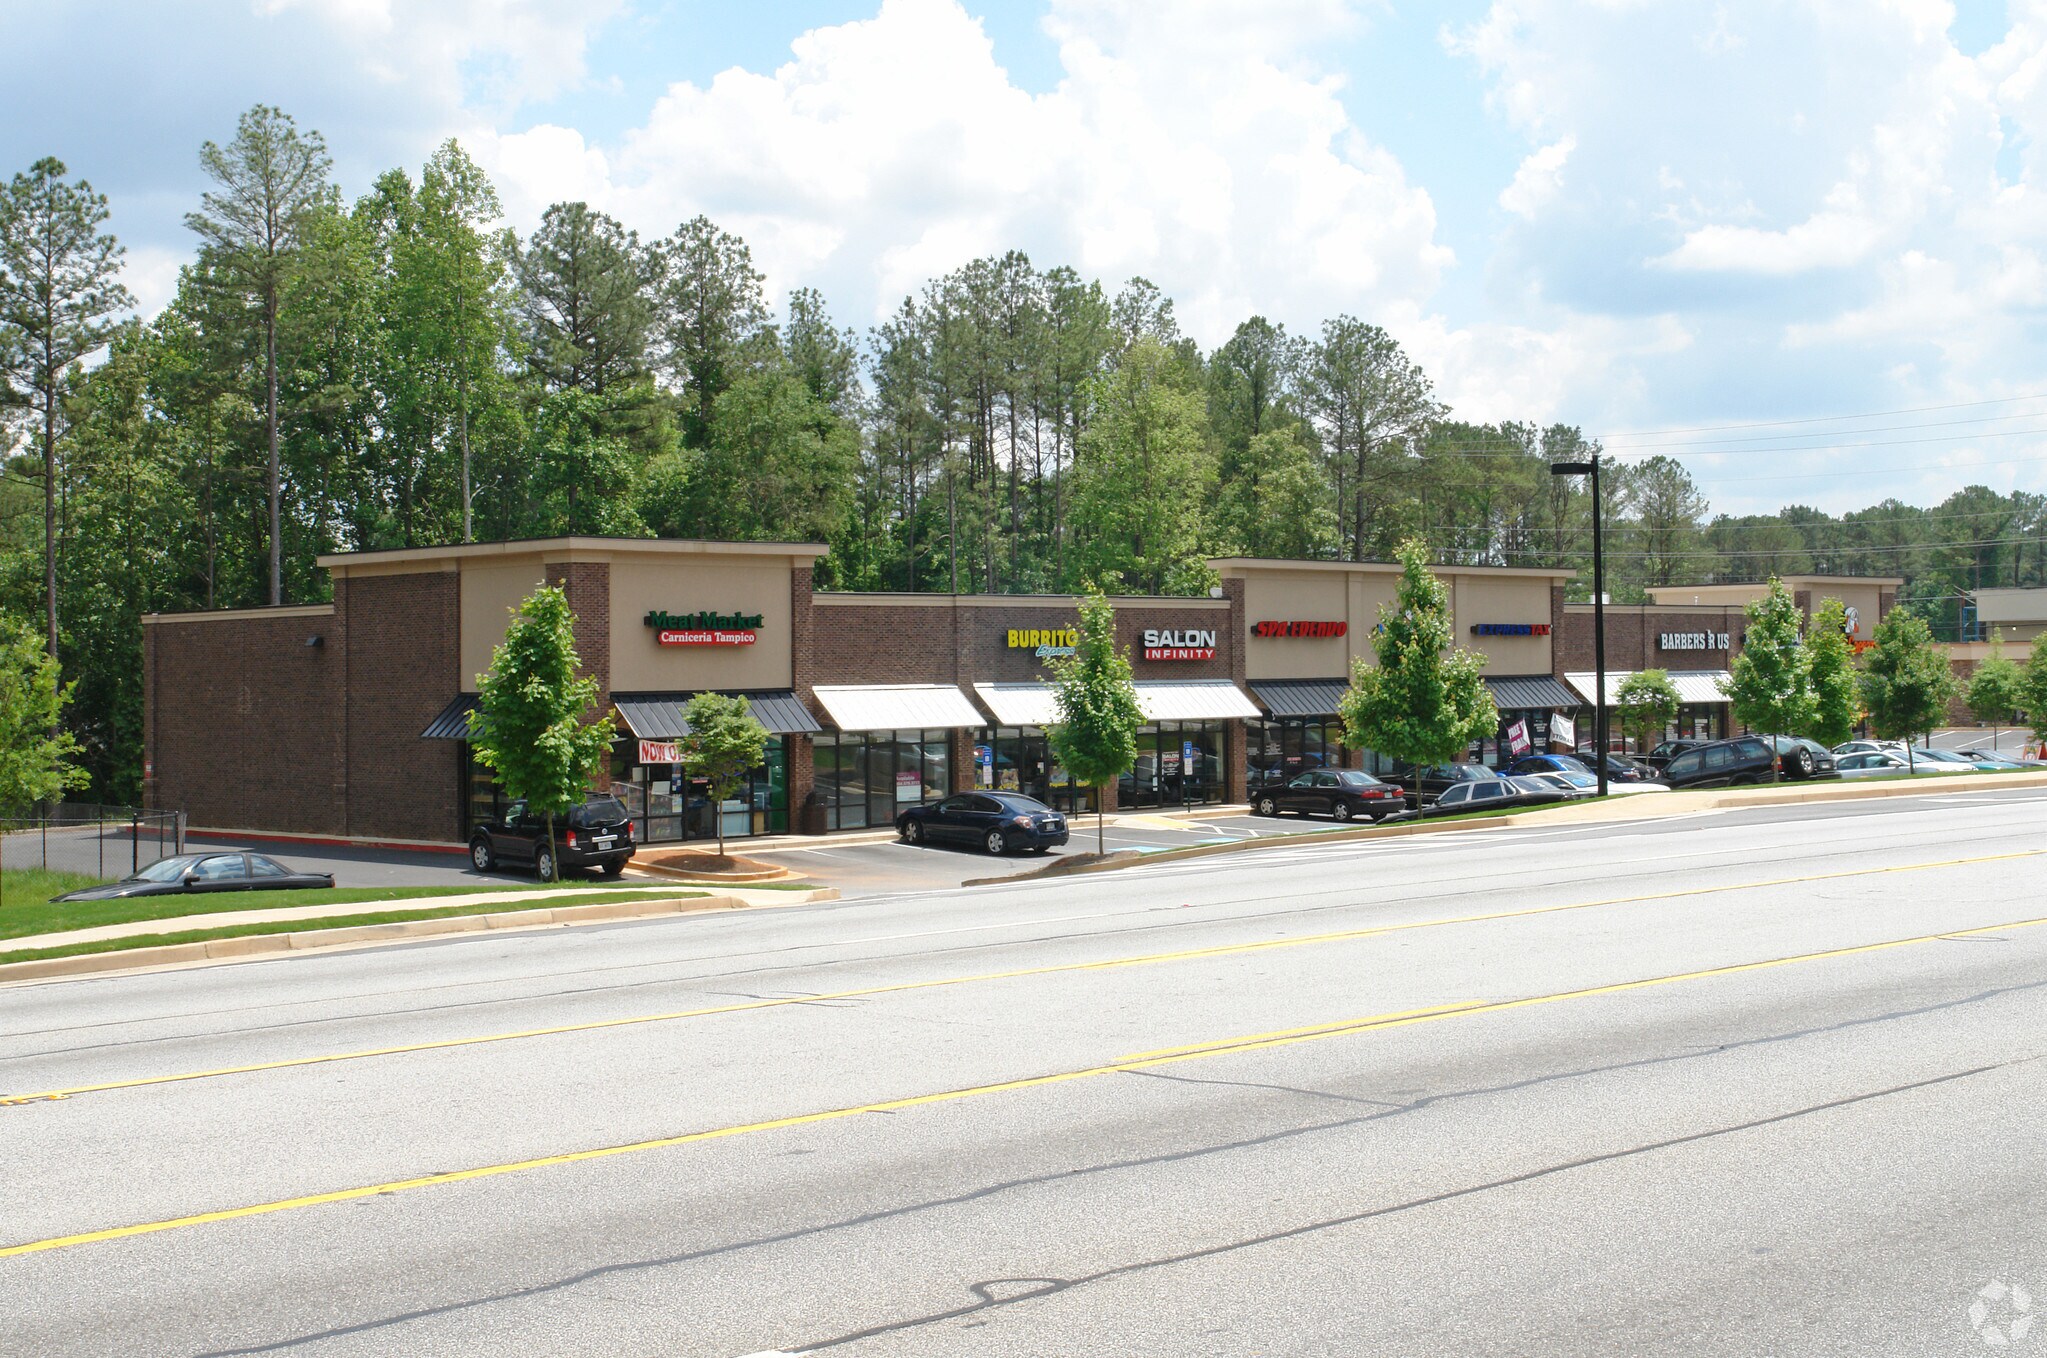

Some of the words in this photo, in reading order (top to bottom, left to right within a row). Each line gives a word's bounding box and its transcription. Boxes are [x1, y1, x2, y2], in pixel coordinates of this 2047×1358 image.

[648, 611, 695, 629] Meat
[699, 611, 764, 629] Market
[660, 632, 712, 642] Carniceria
[714, 632, 755, 644] Tampico
[1257, 621, 1288, 638] SPA
[1007, 629, 1079, 648] BURRITO
[1144, 630, 1216, 647] SALON
[1661, 633, 1706, 649] BARBERS
[1717, 633, 1730, 649] US
[1145, 649, 1214, 659] INFINITY
[641, 742, 666, 761] NOW
